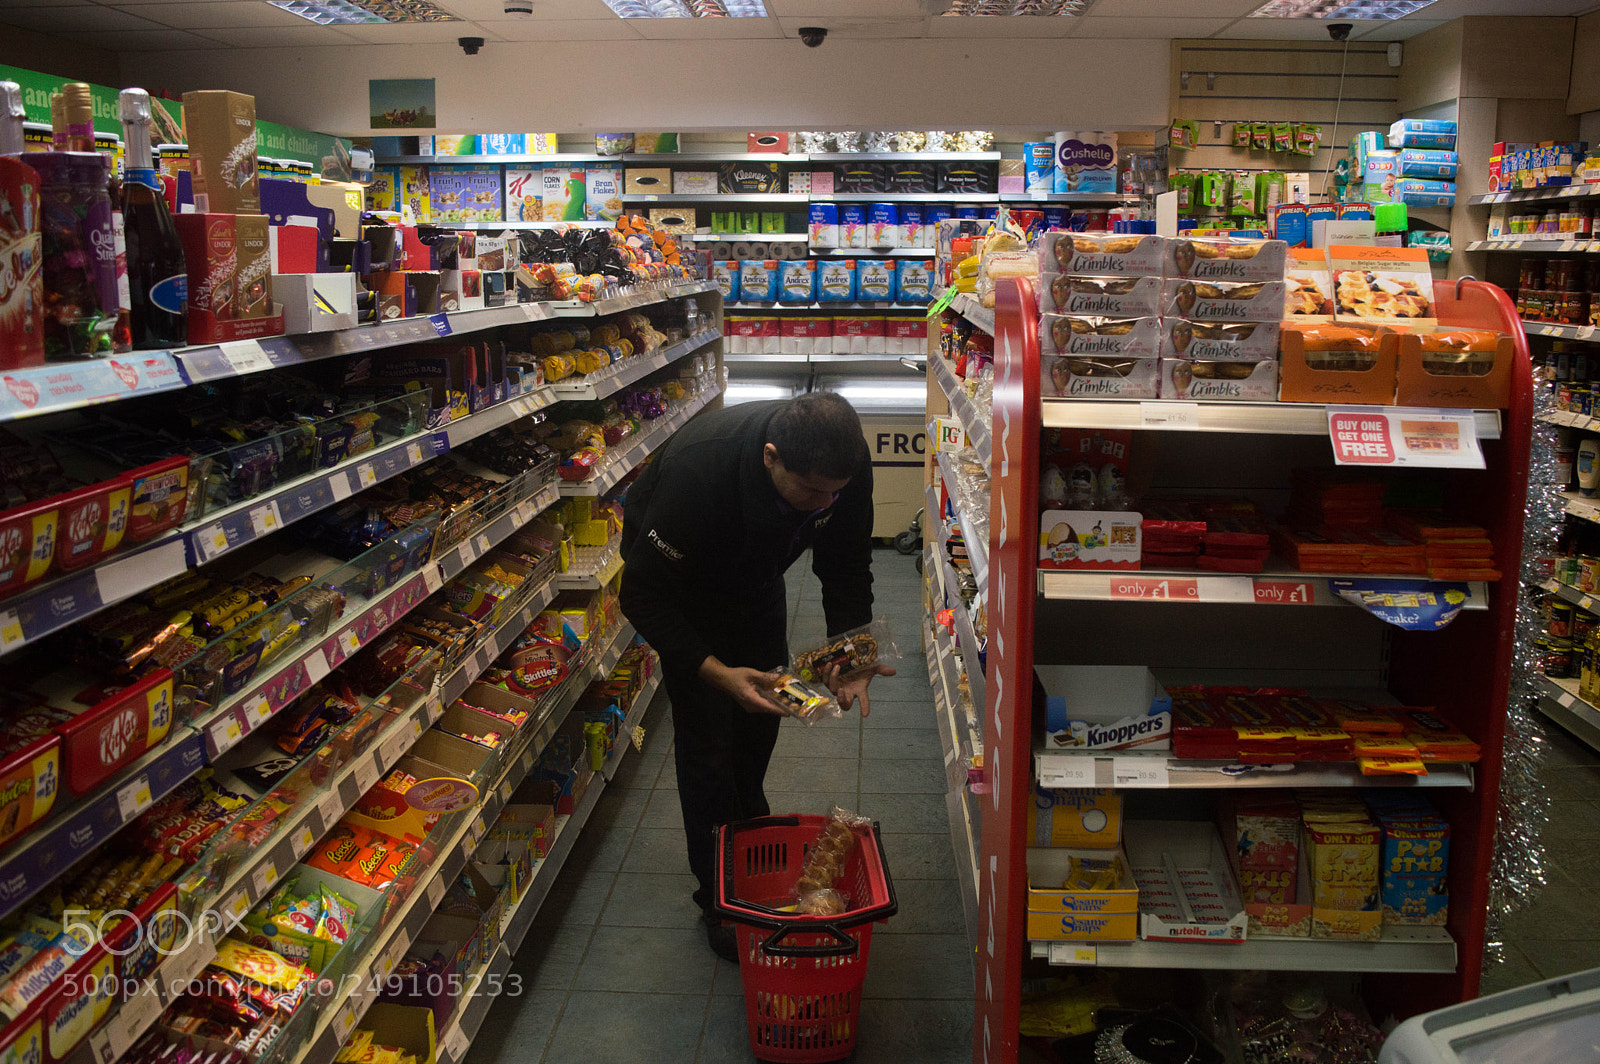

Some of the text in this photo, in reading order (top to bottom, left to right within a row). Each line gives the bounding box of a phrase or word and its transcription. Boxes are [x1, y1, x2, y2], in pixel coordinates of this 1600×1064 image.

[236, 118, 251, 127] LINDOR
[267, 132, 285, 150] and
[288, 135, 318, 156] chilled
[1062, 147, 1110, 160] Cushelle
[468, 176, 496, 188] Fruit n
[733, 170, 767, 182] Kleenex
[455, 180, 462, 189] n
[509, 173, 532, 198] K
[1074, 255, 1124, 272] Crimble's
[1194, 261, 1246, 277] Crimble's
[786, 276, 809, 284] Andrex
[903, 276, 927, 284] Andrex
[1070, 296, 1121, 312] Crimble's
[1195, 302, 1246, 318] Crimble's
[1070, 337, 1121, 353] Crimble's
[422, 366, 441, 374] BARS
[1337, 421, 1382, 431] BUY ONE
[942, 426, 958, 444] PG
[1338, 432, 1384, 442] GET ONE
[876, 433, 925, 454] FRO
[1341, 442, 1388, 457] FREE
[120, 500, 125, 514] 2
[46, 524, 52, 541] 2
[647, 529, 684, 560] Premier
[992, 326, 1012, 811] AMAZING
[1118, 584, 1146, 597] only
[1152, 581, 1169, 598] £1
[1256, 584, 1308, 602] only £1
[1387, 613, 1420, 624] cake?
[523, 668, 558, 684] Skittles
[161, 689, 167, 707] 2
[159, 710, 169, 728] £1
[100, 710, 138, 766] KitKat
[1087, 716, 1163, 747] Knoppers
[48, 760, 53, 777] 2
[44, 779, 56, 798] £1
[422, 783, 452, 803] Starburst
[1324, 835, 1351, 844] ONLY
[326, 839, 355, 864] Reese's
[359, 846, 388, 876] Reese's
[1062, 896, 1108, 911] Sesame
[1061, 916, 1108, 932] Sesame
[1170, 927, 1206, 936] nutella
[20, 956, 65, 1001] Milkybar
[55, 995, 89, 1032] Milkybar
